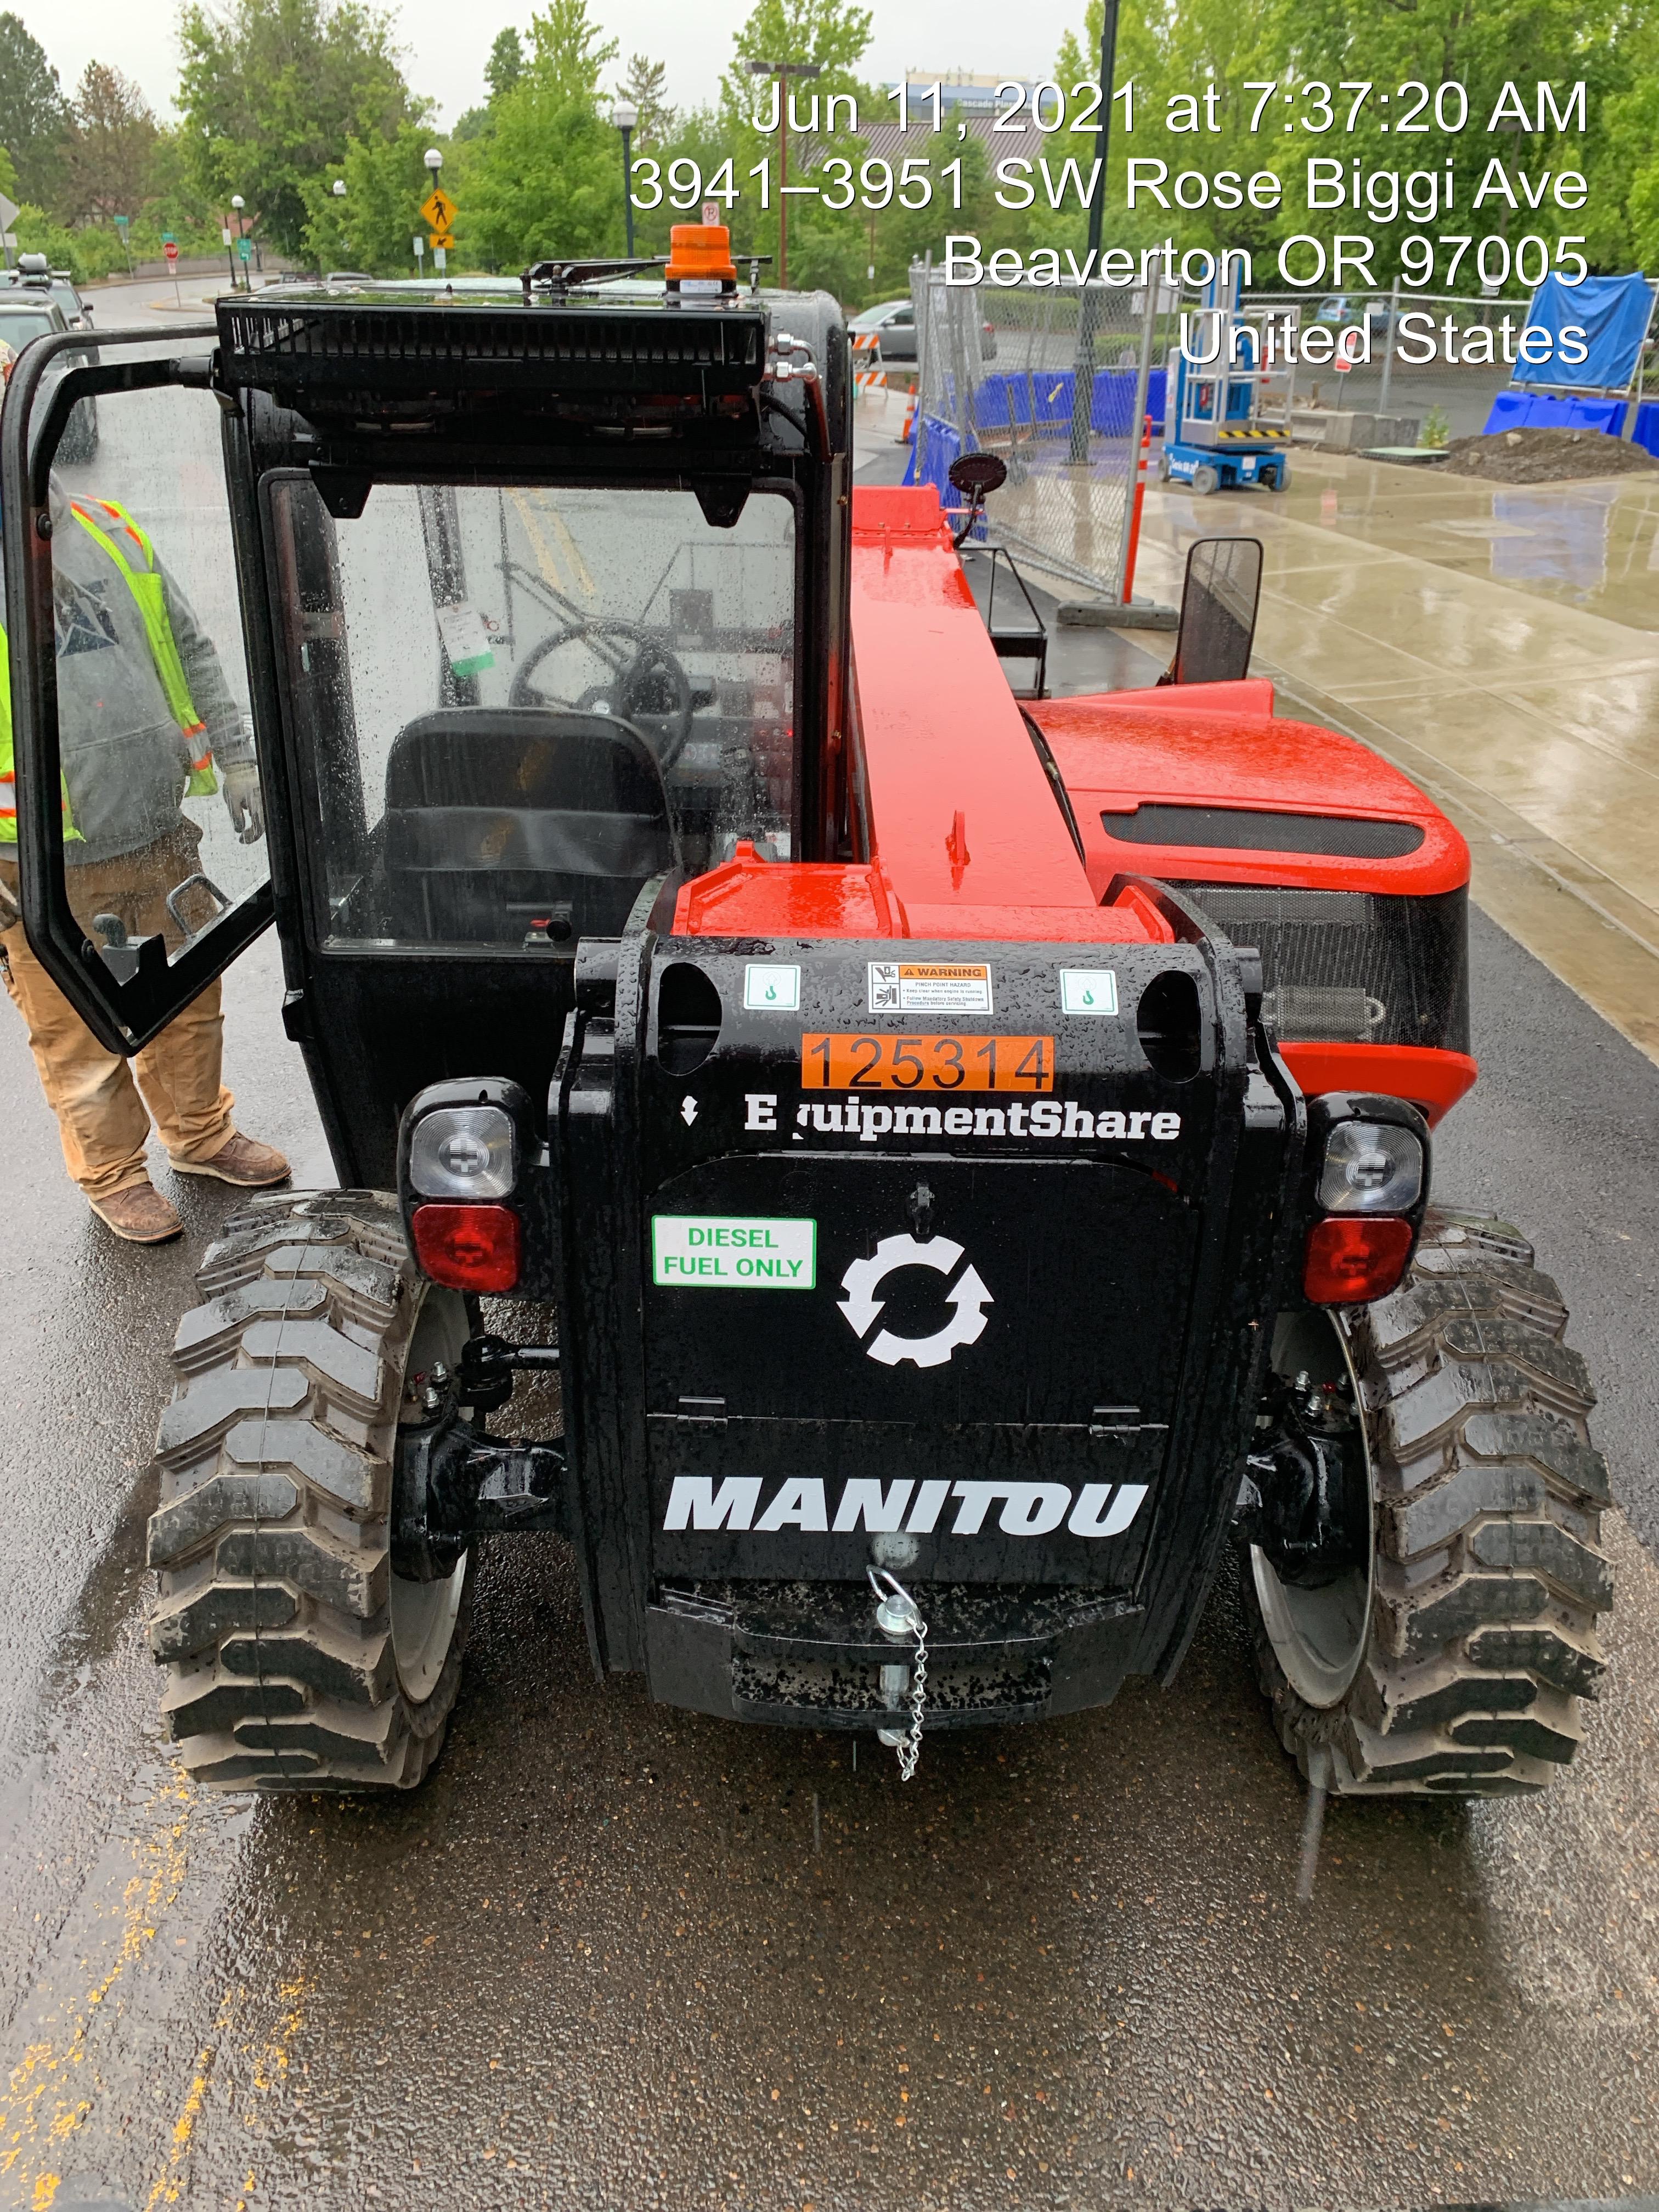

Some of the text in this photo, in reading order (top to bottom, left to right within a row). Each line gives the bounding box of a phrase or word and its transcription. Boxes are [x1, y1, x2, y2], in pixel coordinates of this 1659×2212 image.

[918, 968, 982, 977] WARNING
[810, 1037, 1050, 1090] 125314
[688, 1227, 777, 1248] DIESEL
[664, 1255, 803, 1278] FUEL ONLY
[663, 1476, 1149, 1537] MANITOU
